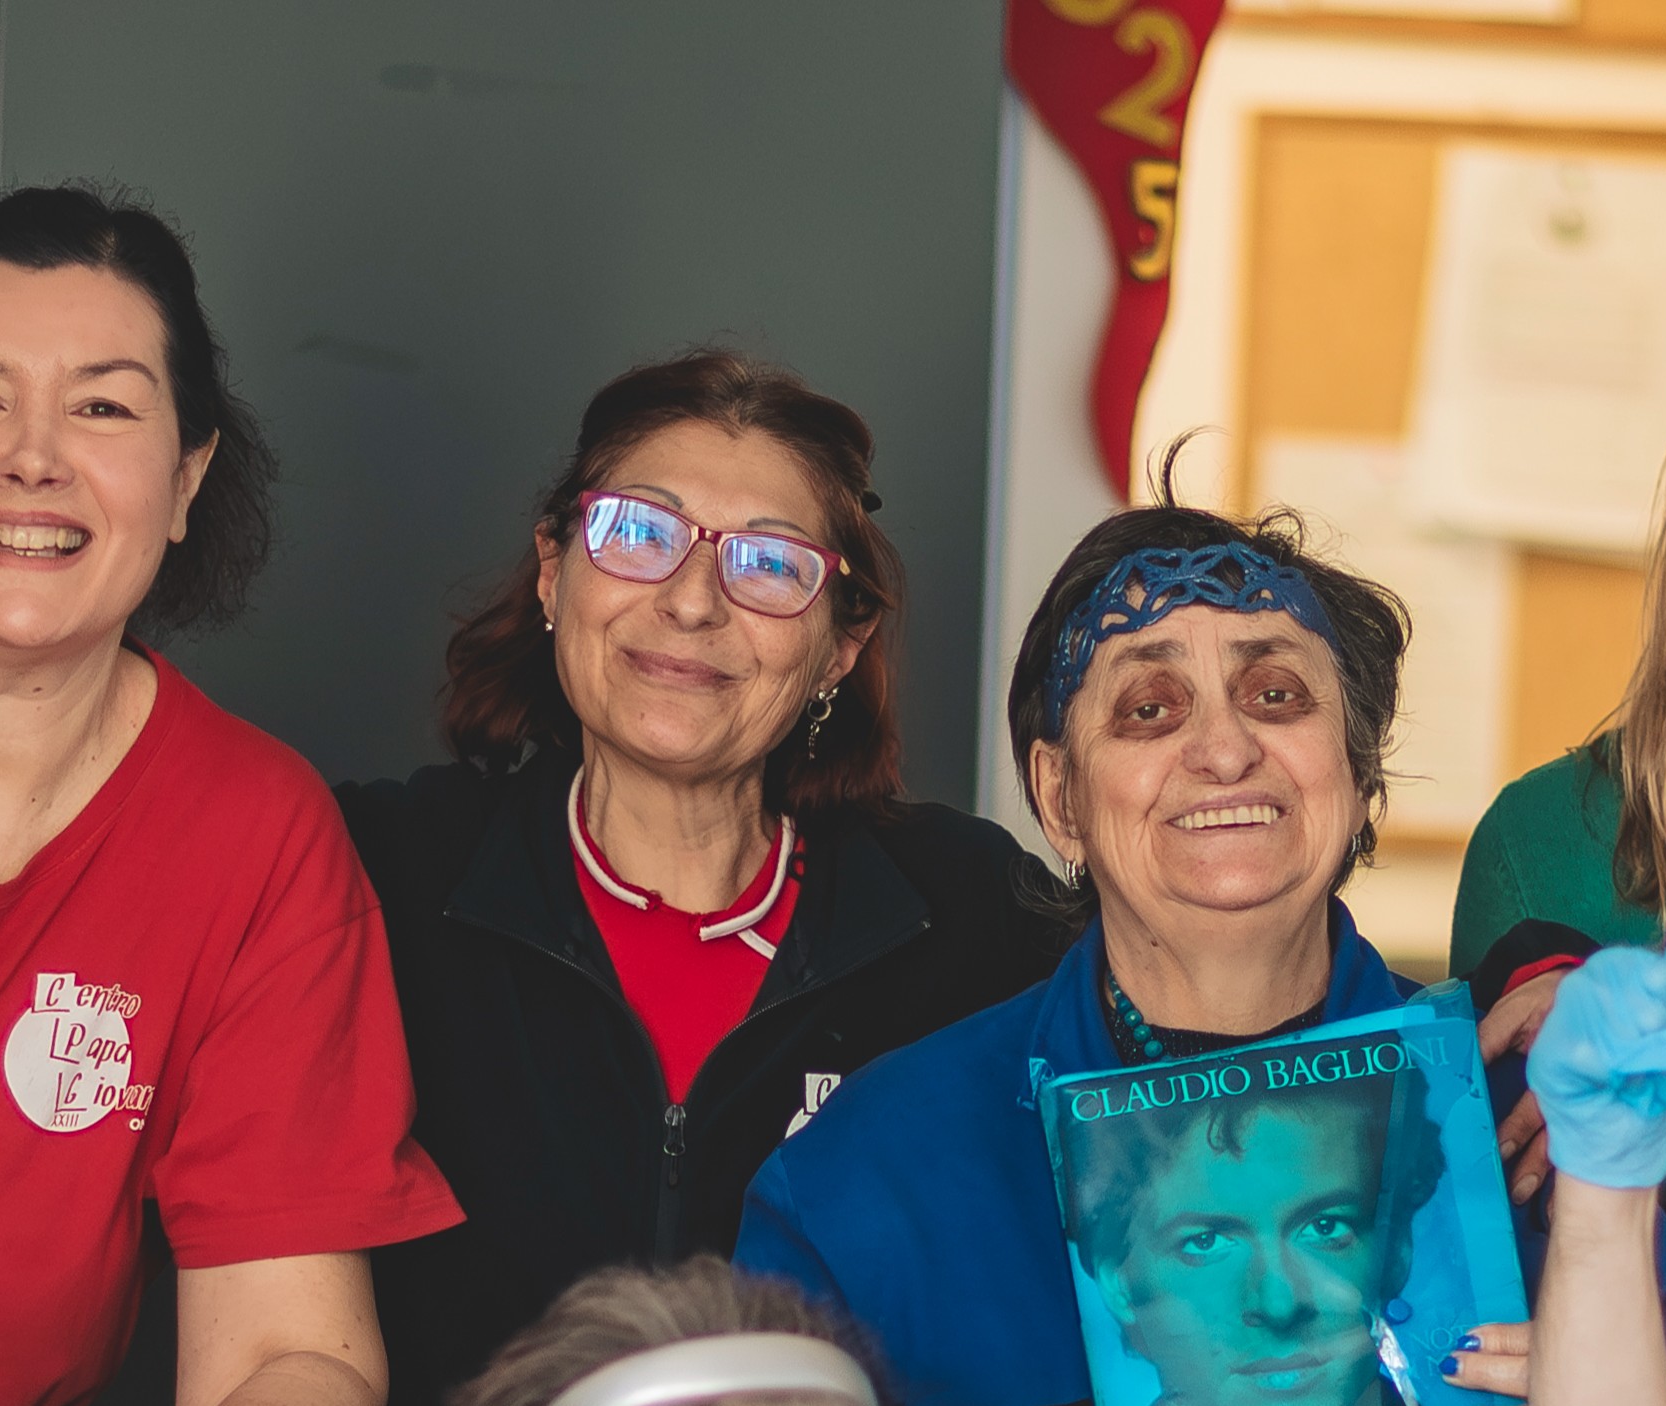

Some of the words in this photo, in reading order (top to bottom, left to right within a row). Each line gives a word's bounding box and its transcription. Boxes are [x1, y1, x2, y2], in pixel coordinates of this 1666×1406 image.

[45, 977, 142, 1018] Centro
[65, 1022, 129, 1070] Papa
[64, 1072, 156, 1116] Giovan
[1071, 1064, 1251, 1121] CLAUDIO
[1262, 1036, 1451, 1090] BAGLIONI
[50, 1113, 80, 1128] XXIII
